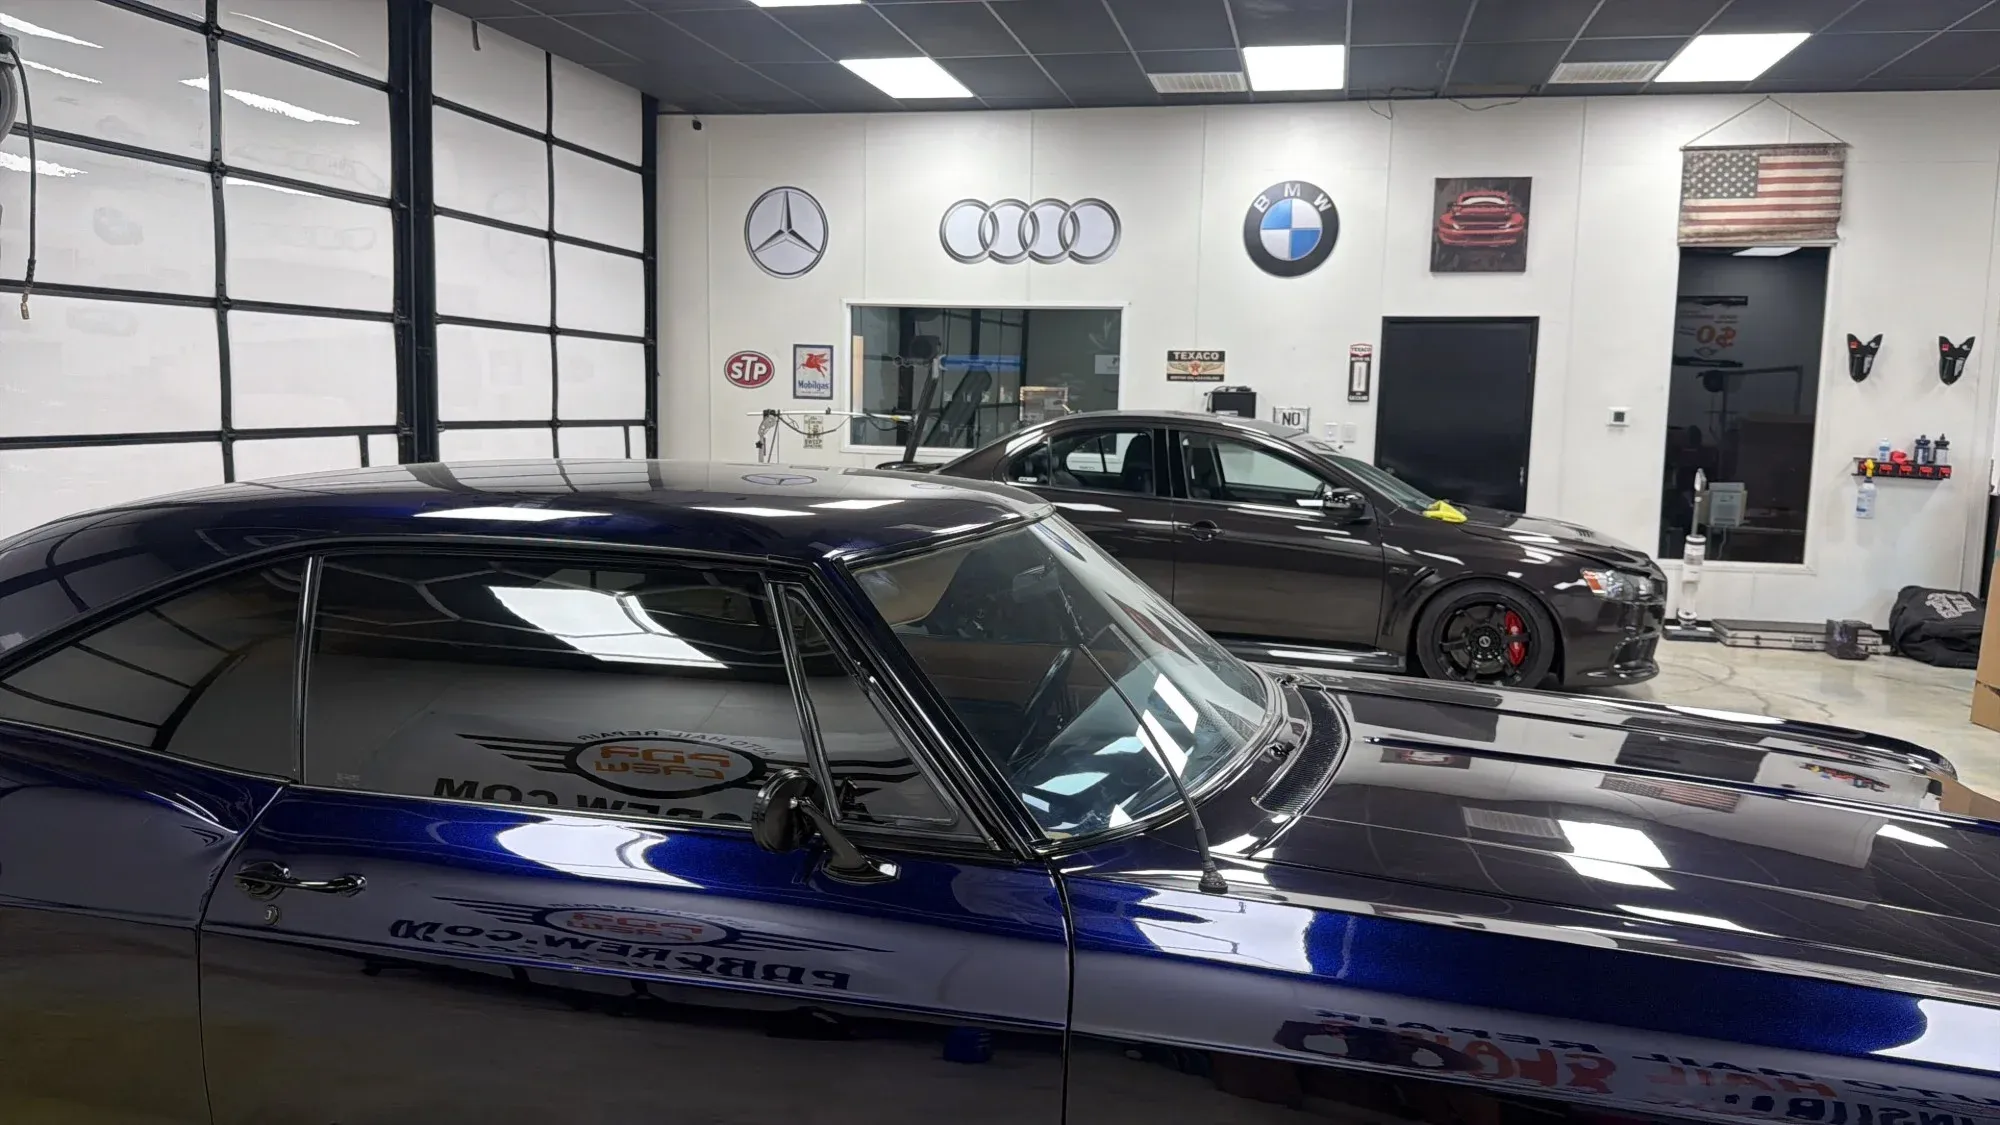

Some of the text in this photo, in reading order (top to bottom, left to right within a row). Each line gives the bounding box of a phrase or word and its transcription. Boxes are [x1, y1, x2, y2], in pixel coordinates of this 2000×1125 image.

[1253, 183, 1332, 213] BMW
[1173, 351, 1220, 360] TEXACO
[730, 356, 768, 381] STP
[798, 380, 829, 391] Mobilgas
[1281, 412, 1300, 426] NO
